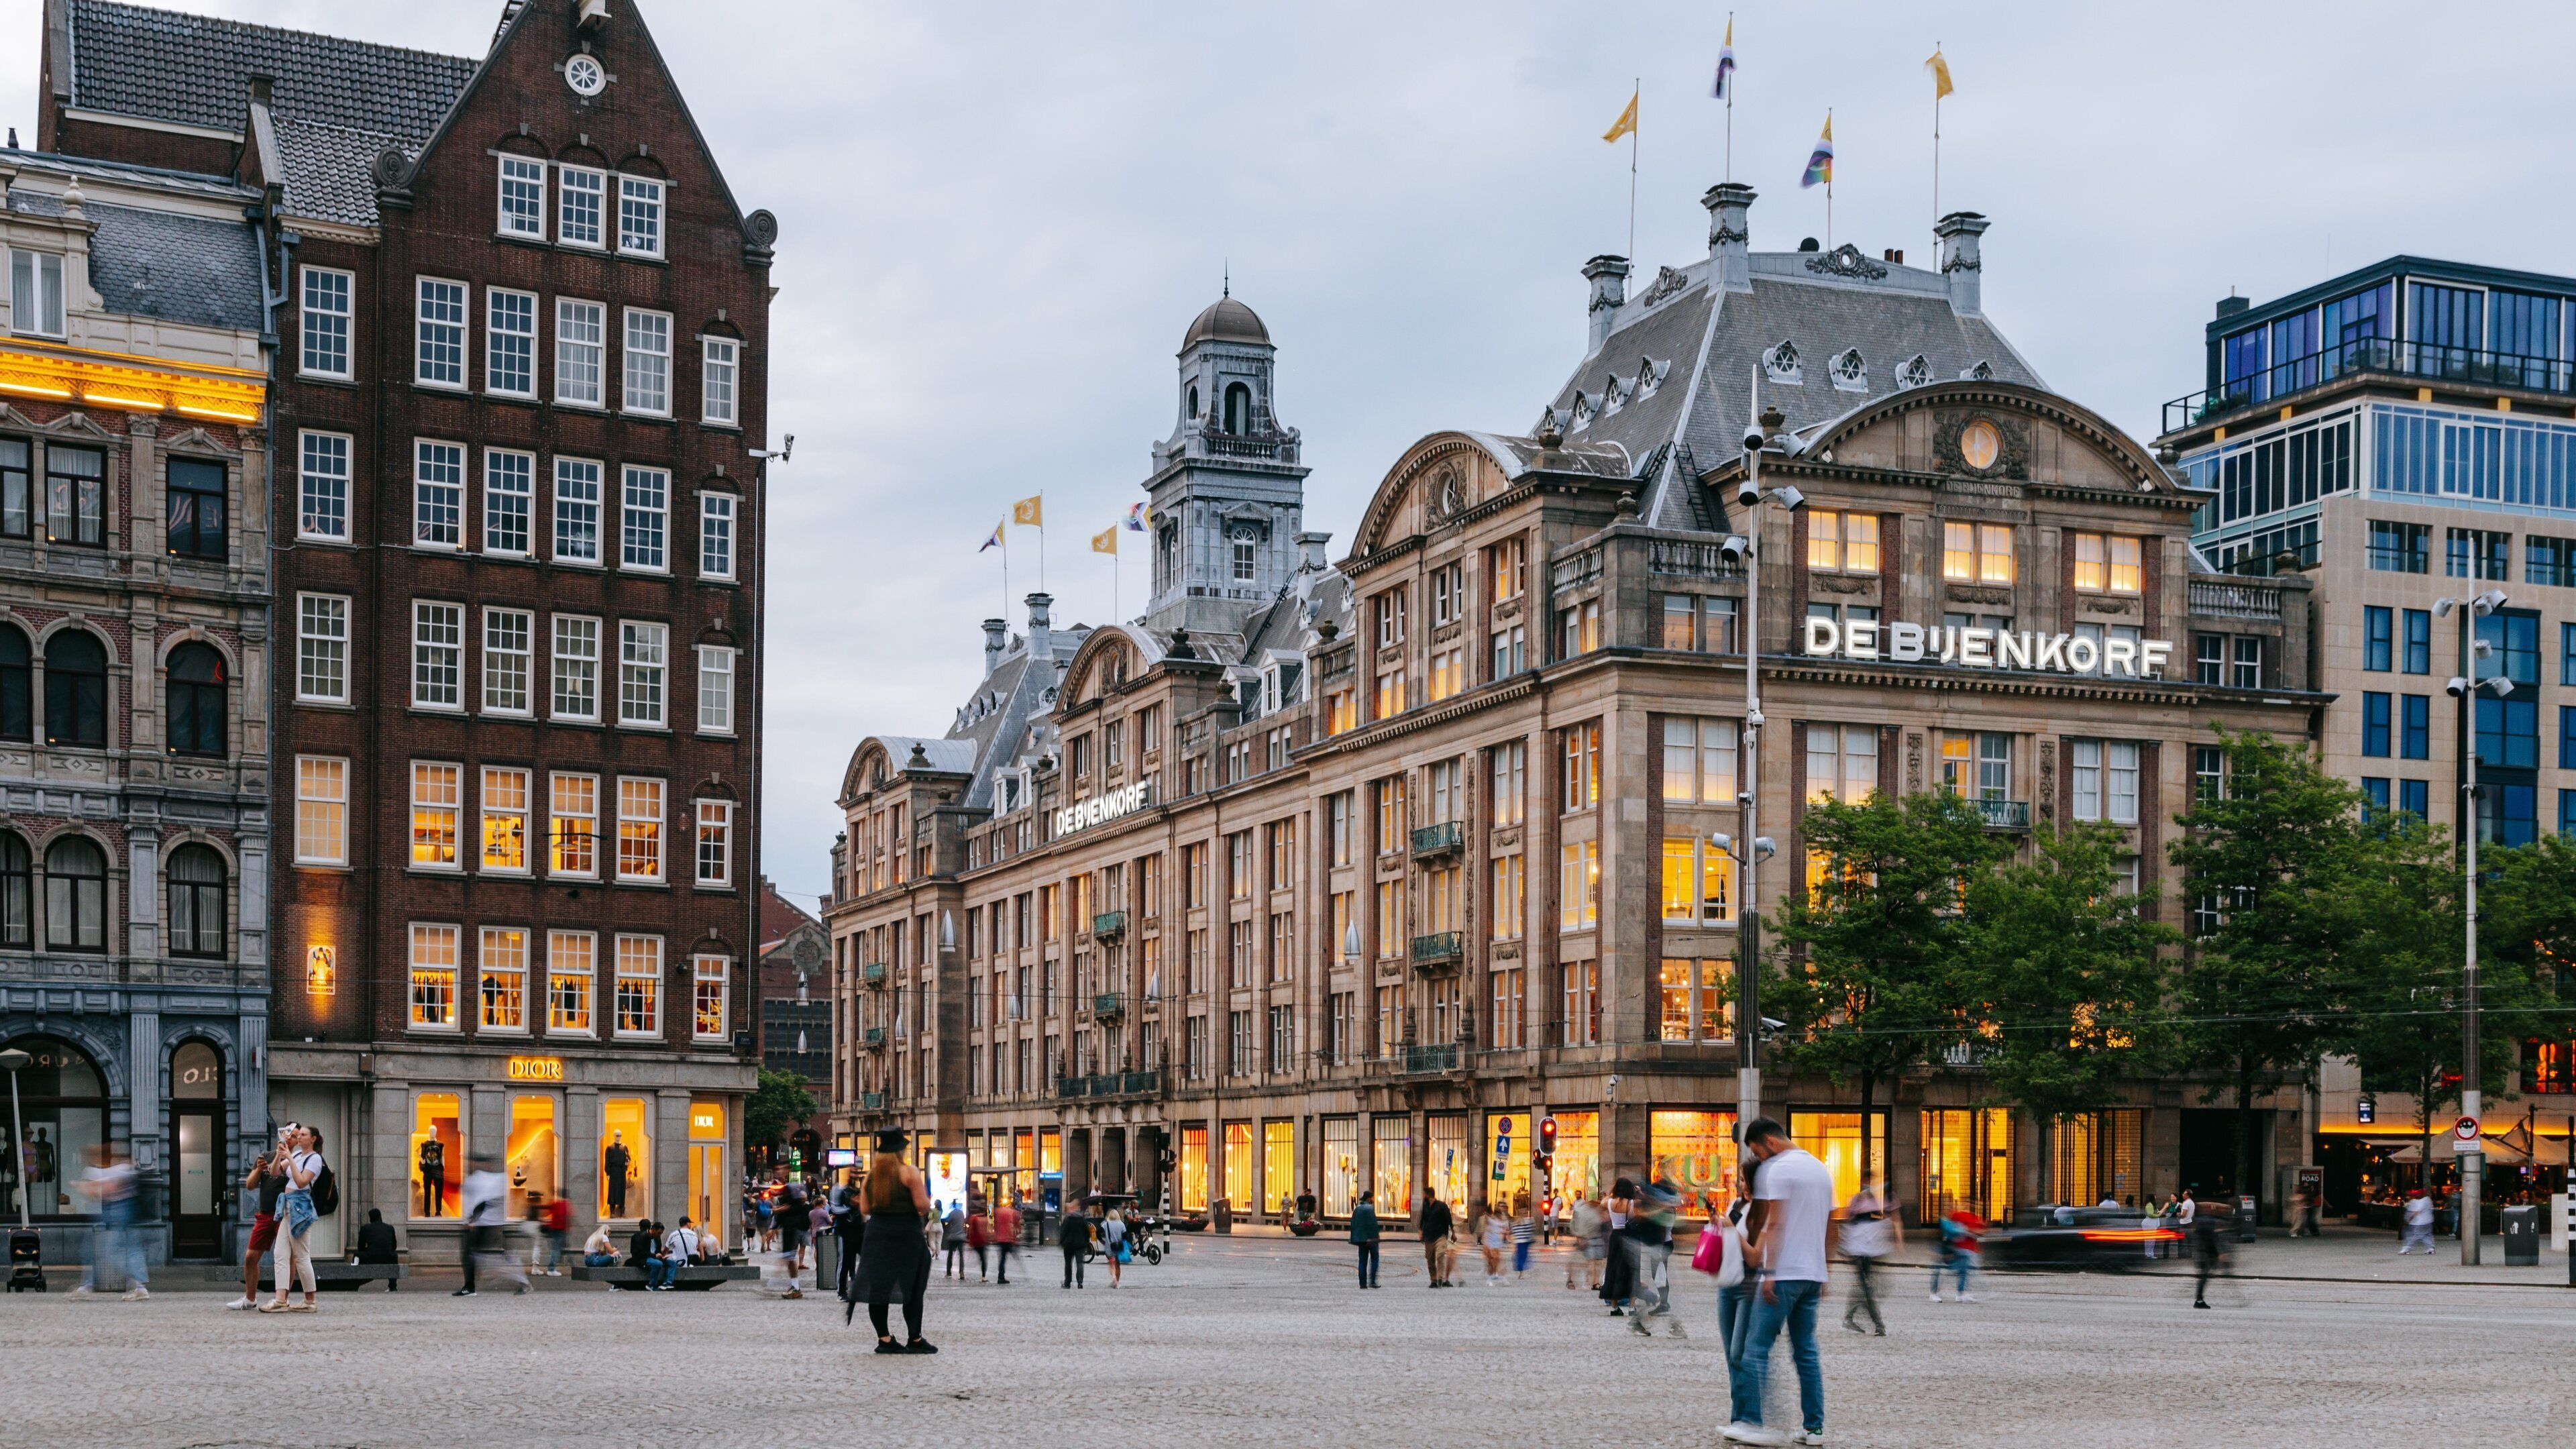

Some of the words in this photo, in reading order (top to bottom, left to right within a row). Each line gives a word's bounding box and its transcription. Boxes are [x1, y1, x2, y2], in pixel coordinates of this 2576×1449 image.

[1806, 615, 1879, 659] DE
[1889, 621, 2174, 676] BIJENKORF
[1057, 806, 1075, 837] DE
[1075, 780, 1147, 831] BIJENKORF
[511, 1061, 562, 1079] DIOR
